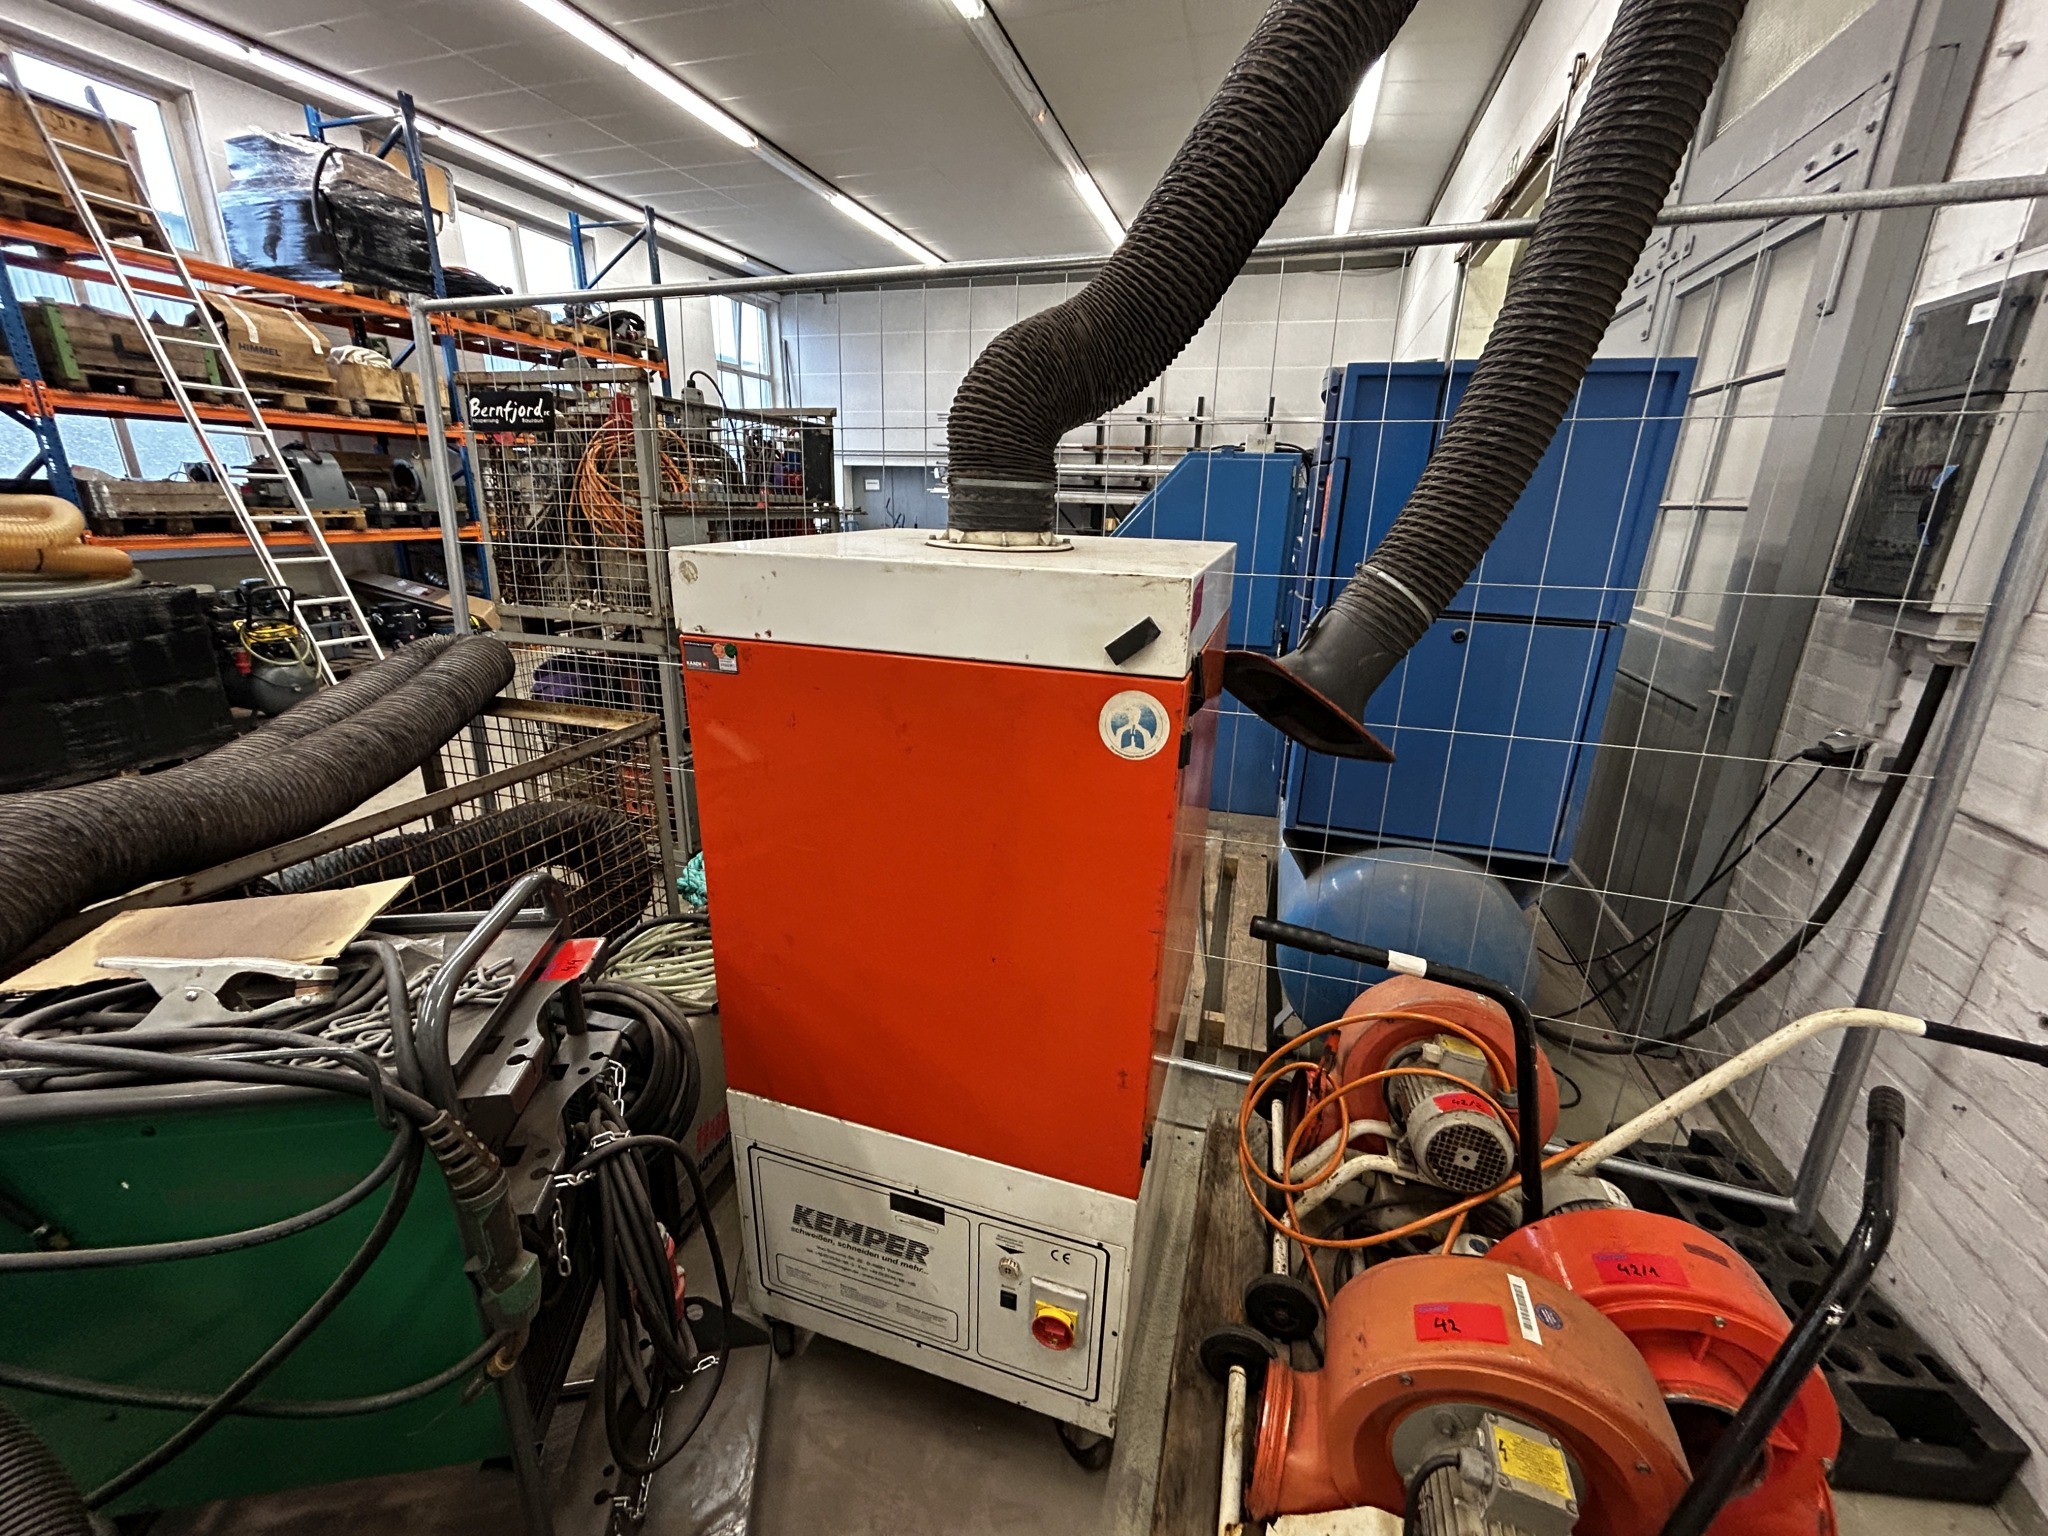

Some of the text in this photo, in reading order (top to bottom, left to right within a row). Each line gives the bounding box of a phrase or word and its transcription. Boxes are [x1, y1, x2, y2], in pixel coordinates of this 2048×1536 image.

[238, 343, 281, 357] HIMMEL
[469, 397, 543, 424] Bernfjord
[790, 1226, 835, 1246] schweißen,
[837, 1241, 880, 1259] schneiden
[881, 1254, 899, 1265] und
[792, 1204, 930, 1266] KEMPER
[1433, 1317, 1461, 1333] 42
